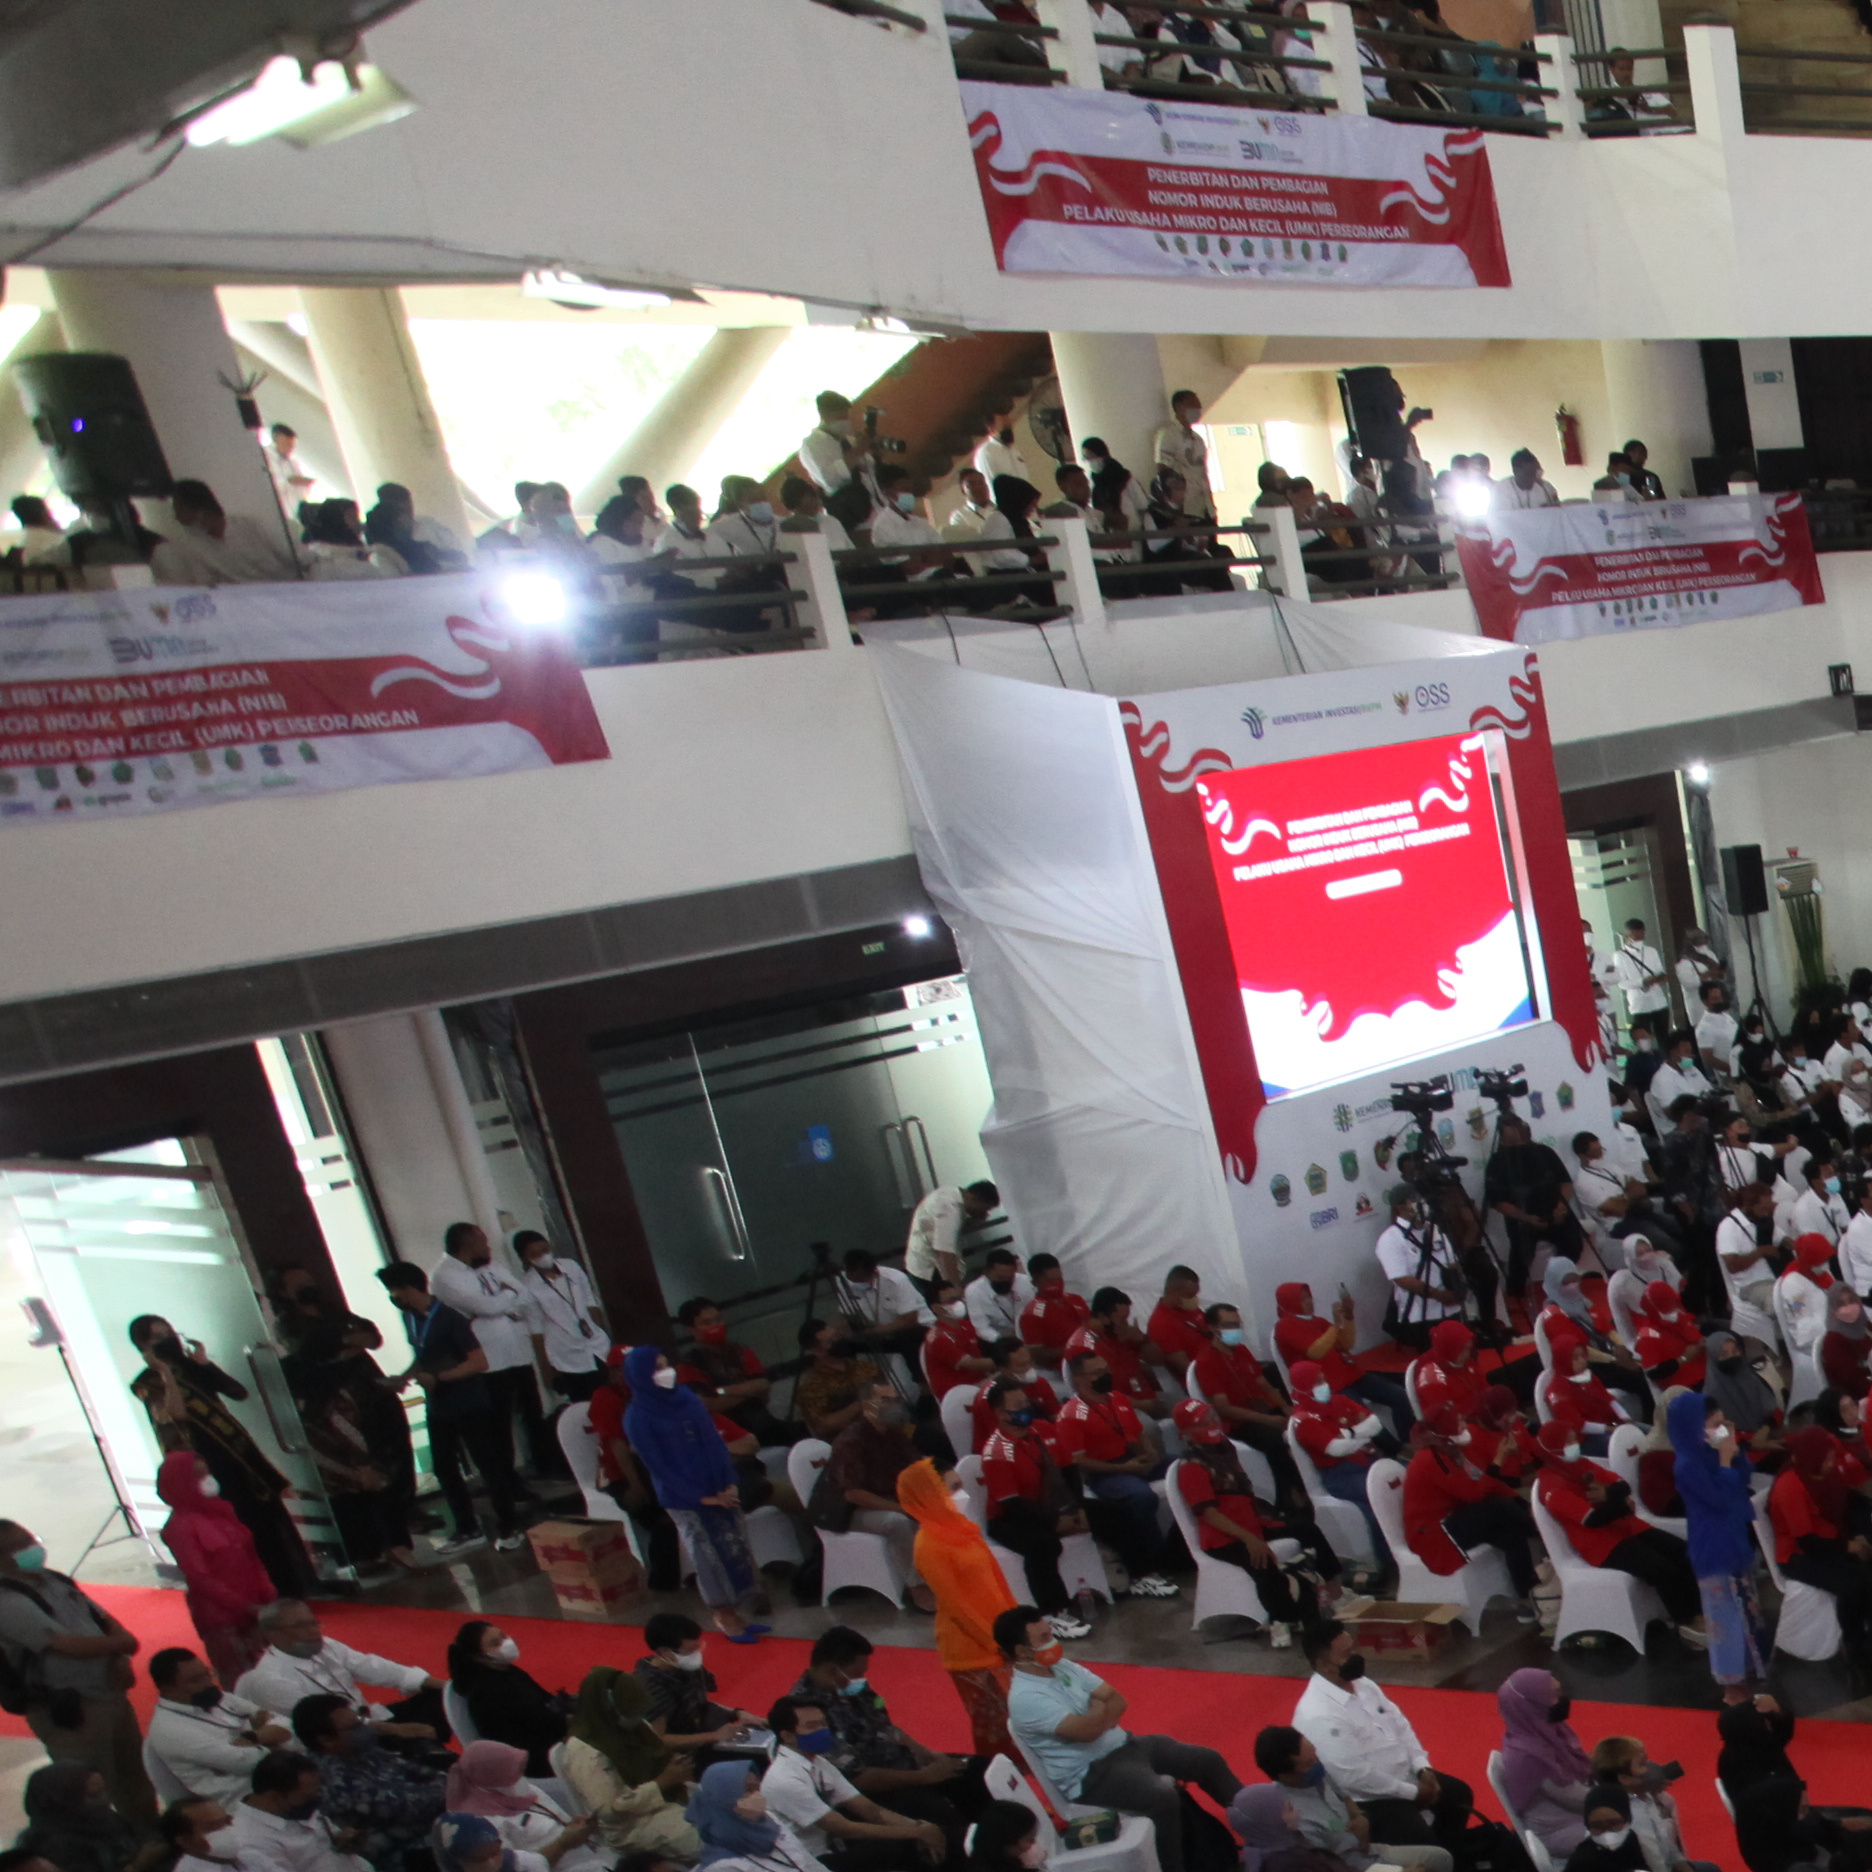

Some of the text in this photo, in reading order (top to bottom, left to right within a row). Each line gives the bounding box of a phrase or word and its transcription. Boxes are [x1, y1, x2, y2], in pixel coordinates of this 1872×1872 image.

[1146, 167, 1330, 195] PENERBITAN DAN PEMBAGIAN
[1146, 189, 1338, 218] NOMOR INDUK BERUSAHA (NIB)
[1062, 204, 1410, 240] PELAKU USAHA MIKRO DAN KECIL (UMK) PERSEORANGAN
[95, 680, 150, 701] DAN
[1271, 710, 1325, 726] KEMENTERIAN
[1414, 682, 1451, 708] OSS
[43, 711, 117, 732] INDUK
[73, 736, 126, 759] DAN
[193, 720, 255, 747] (UMK)
